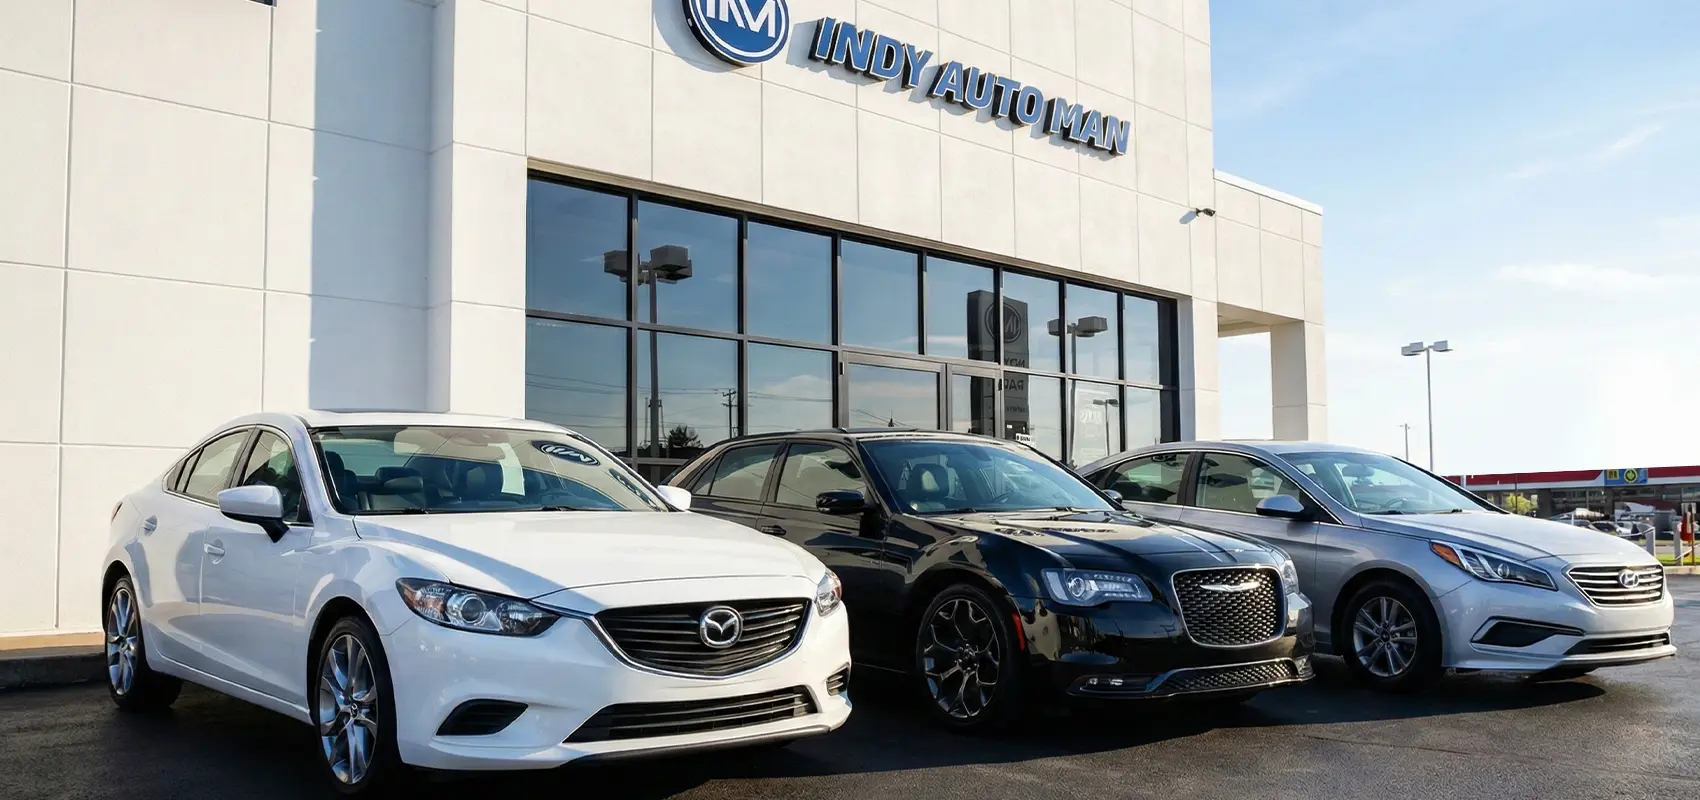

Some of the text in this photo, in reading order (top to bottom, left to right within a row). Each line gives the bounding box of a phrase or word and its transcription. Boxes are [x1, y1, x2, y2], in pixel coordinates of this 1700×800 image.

[813, 16, 1131, 155] INDY AUTO MAN
